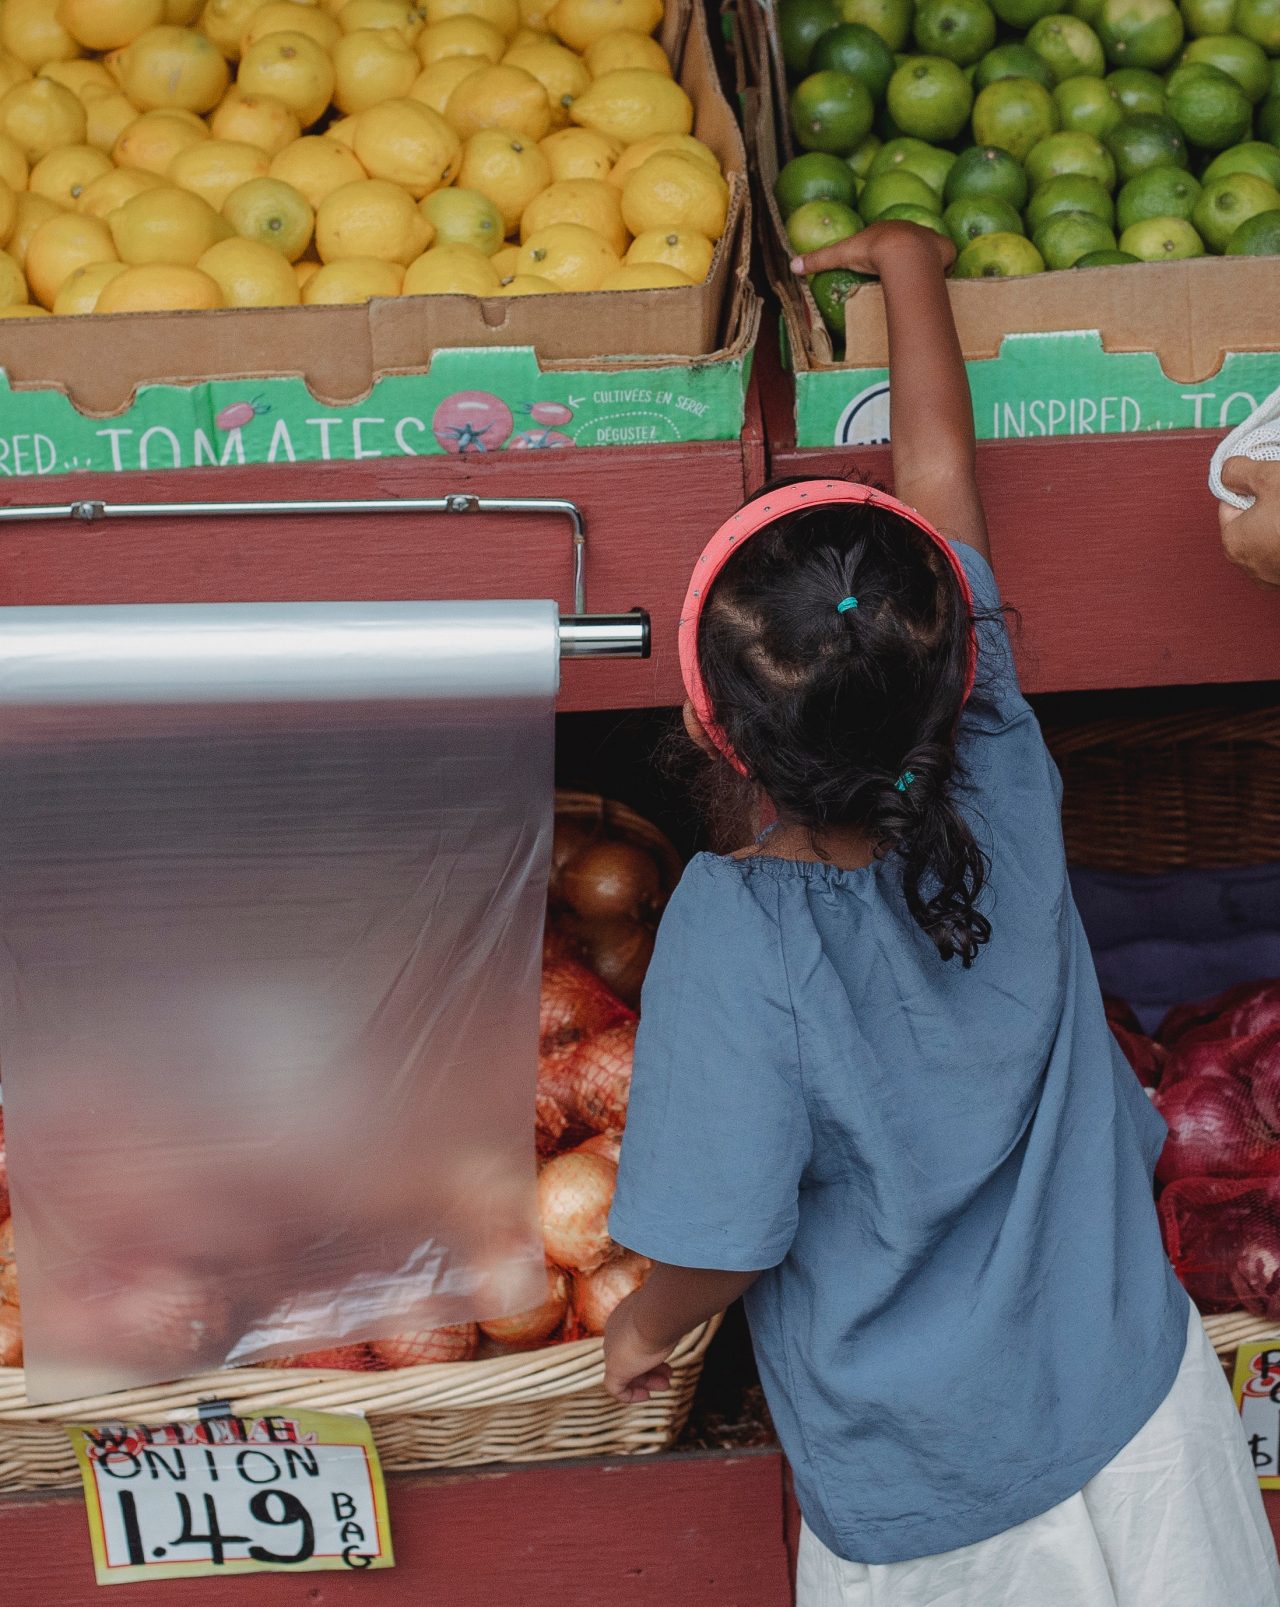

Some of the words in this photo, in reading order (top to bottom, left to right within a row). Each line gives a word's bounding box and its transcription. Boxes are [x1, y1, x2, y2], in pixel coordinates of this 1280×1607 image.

[593, 388, 653, 404] CULTIVÉES
[655, 391, 673, 405] EN
[675, 395, 711, 418] SERRE
[96, 416, 426, 471] TOMATES
[596, 425, 657, 442] DÉGUSTEZ
[98, 1447, 320, 1484] ONION
[118, 1488, 316, 1565] 1.49
[331, 1491, 376, 1570] BAG
